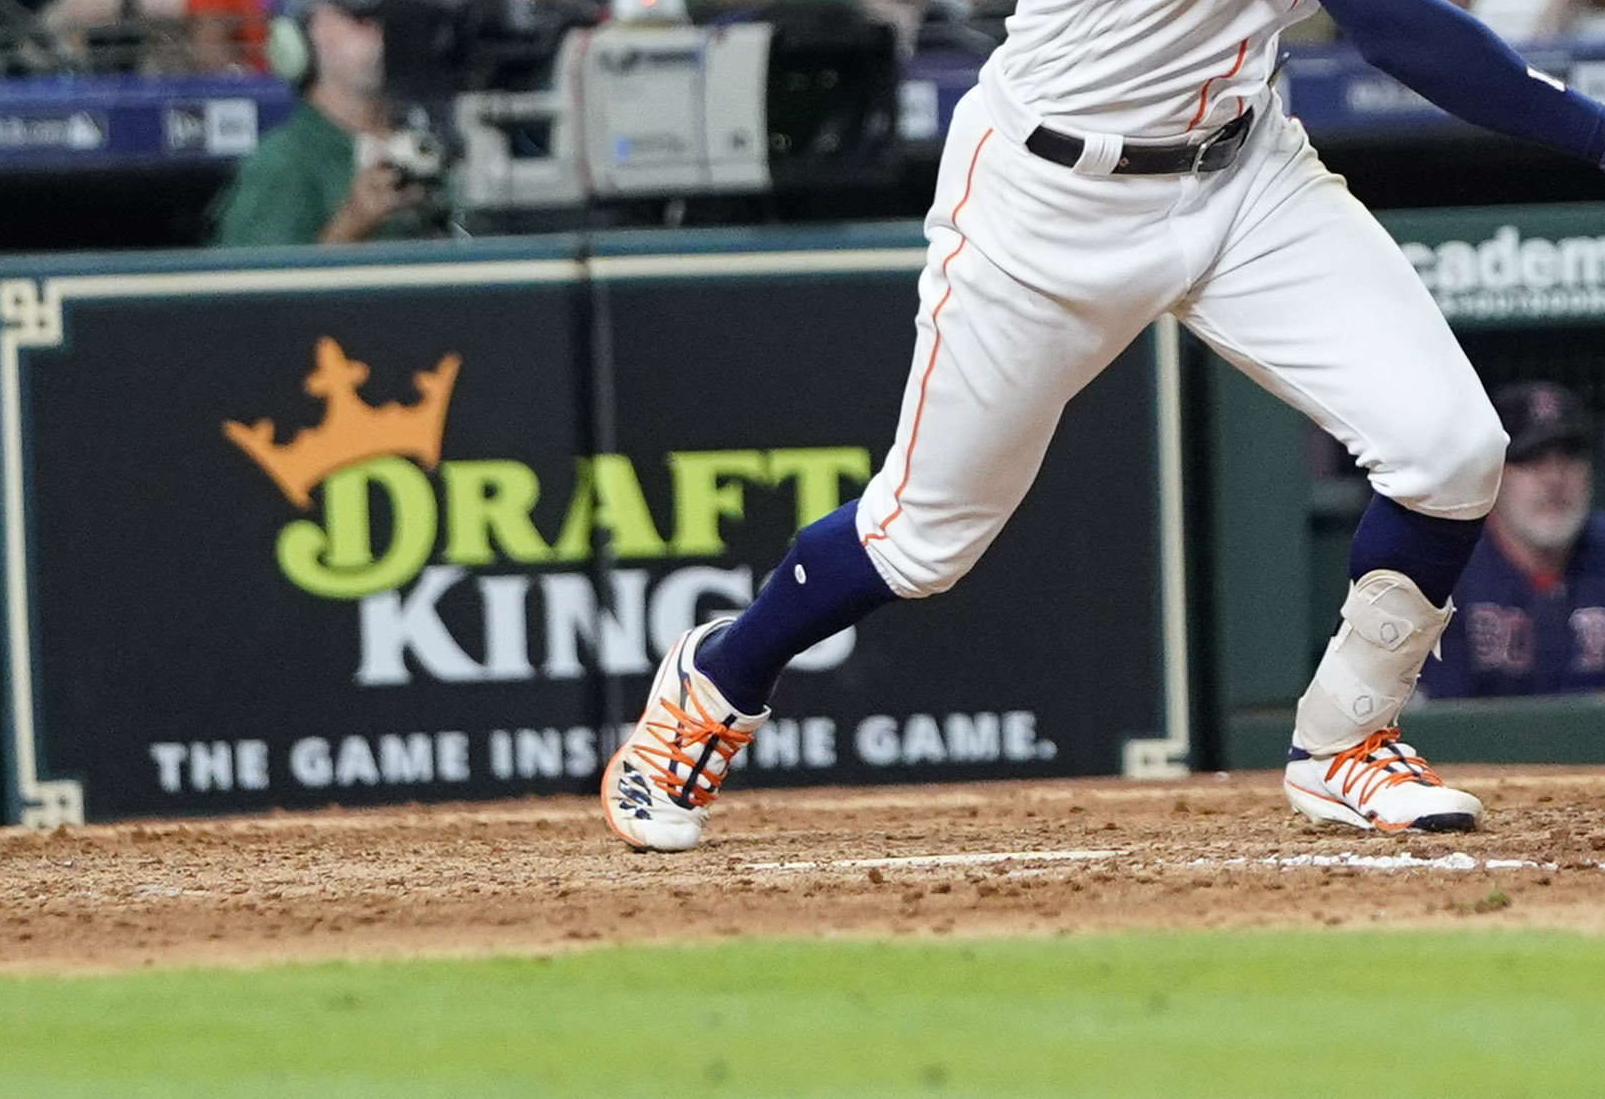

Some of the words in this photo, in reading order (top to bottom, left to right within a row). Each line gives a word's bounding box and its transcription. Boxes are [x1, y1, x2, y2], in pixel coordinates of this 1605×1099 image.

[275, 447, 871, 601] DRAFT
[150, 739, 270, 792] THE
[288, 733, 472, 790] GAME
[854, 712, 1057, 765] GAME.
